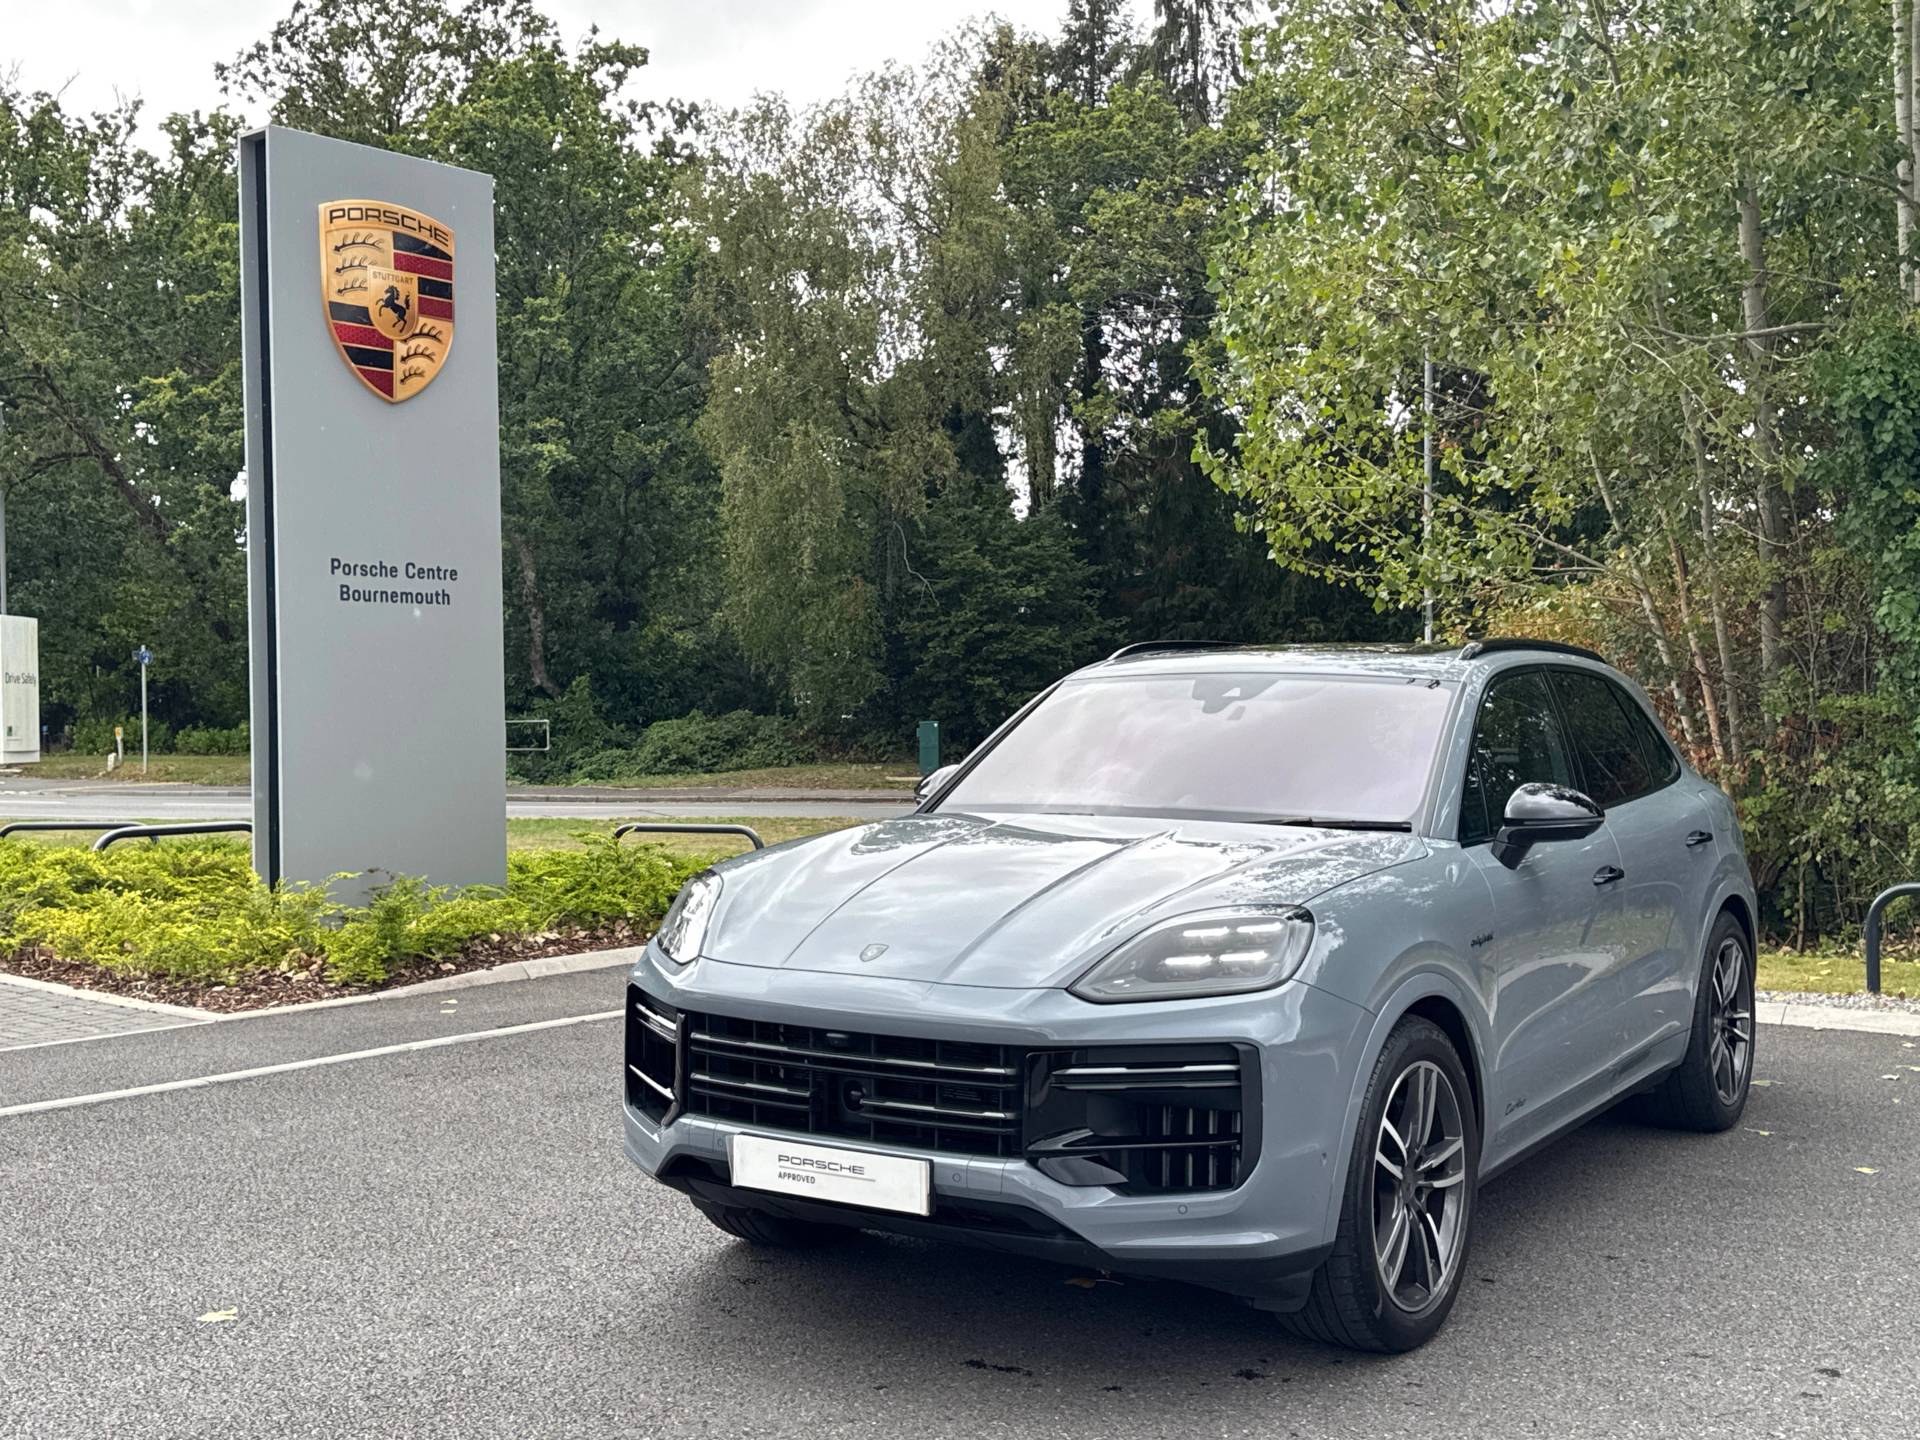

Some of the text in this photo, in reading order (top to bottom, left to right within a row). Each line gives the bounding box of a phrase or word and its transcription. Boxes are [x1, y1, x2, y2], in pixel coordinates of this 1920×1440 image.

[329, 207, 449, 247] PORSCHE
[372, 270, 414, 284] STUTTGART
[330, 557, 458, 581] Porsche Centre
[339, 584, 451, 605] Bournemouth
[5, 671, 36, 687] Drive Safely
[778, 1154, 865, 1175] PORSCHE
[778, 1171, 815, 1184] APPROVED
